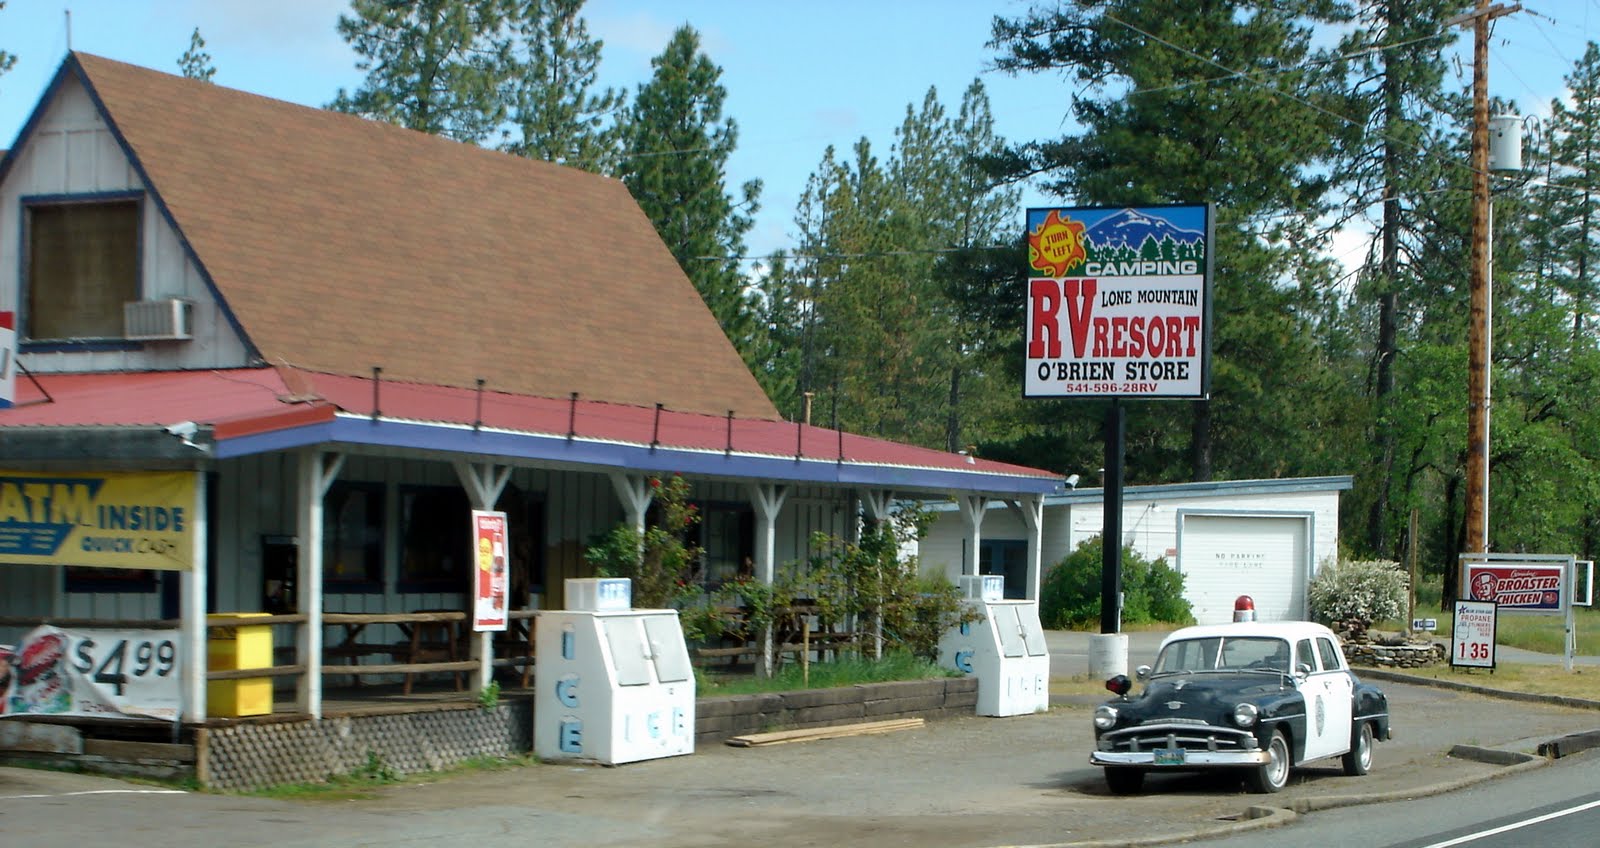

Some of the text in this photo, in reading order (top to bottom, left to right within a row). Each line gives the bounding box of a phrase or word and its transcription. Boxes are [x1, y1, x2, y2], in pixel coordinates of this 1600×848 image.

[1045, 230, 1069, 244] TURN
[1053, 244, 1072, 258] LEFT
[1085, 260, 1198, 277] CAMPING
[1101, 289, 1199, 308] LONE MOUNTAIN
[1028, 279, 1098, 359] RV
[1092, 315, 1200, 359] RESORT
[1037, 361, 1190, 382] O'BRIEN STORE
[1066, 382, 1158, 393] 541-596-28RV
[0, 483, 94, 524] ATM
[97, 504, 184, 532] INSIDE
[81, 536, 133, 553] QUICK
[1215, 552, 1226, 560] NO
[1497, 577, 1558, 591] BROASTER
[1497, 592, 1542, 605] CHICKEN
[1461, 614, 1492, 622] PROPANE
[556, 622, 583, 754] ICE
